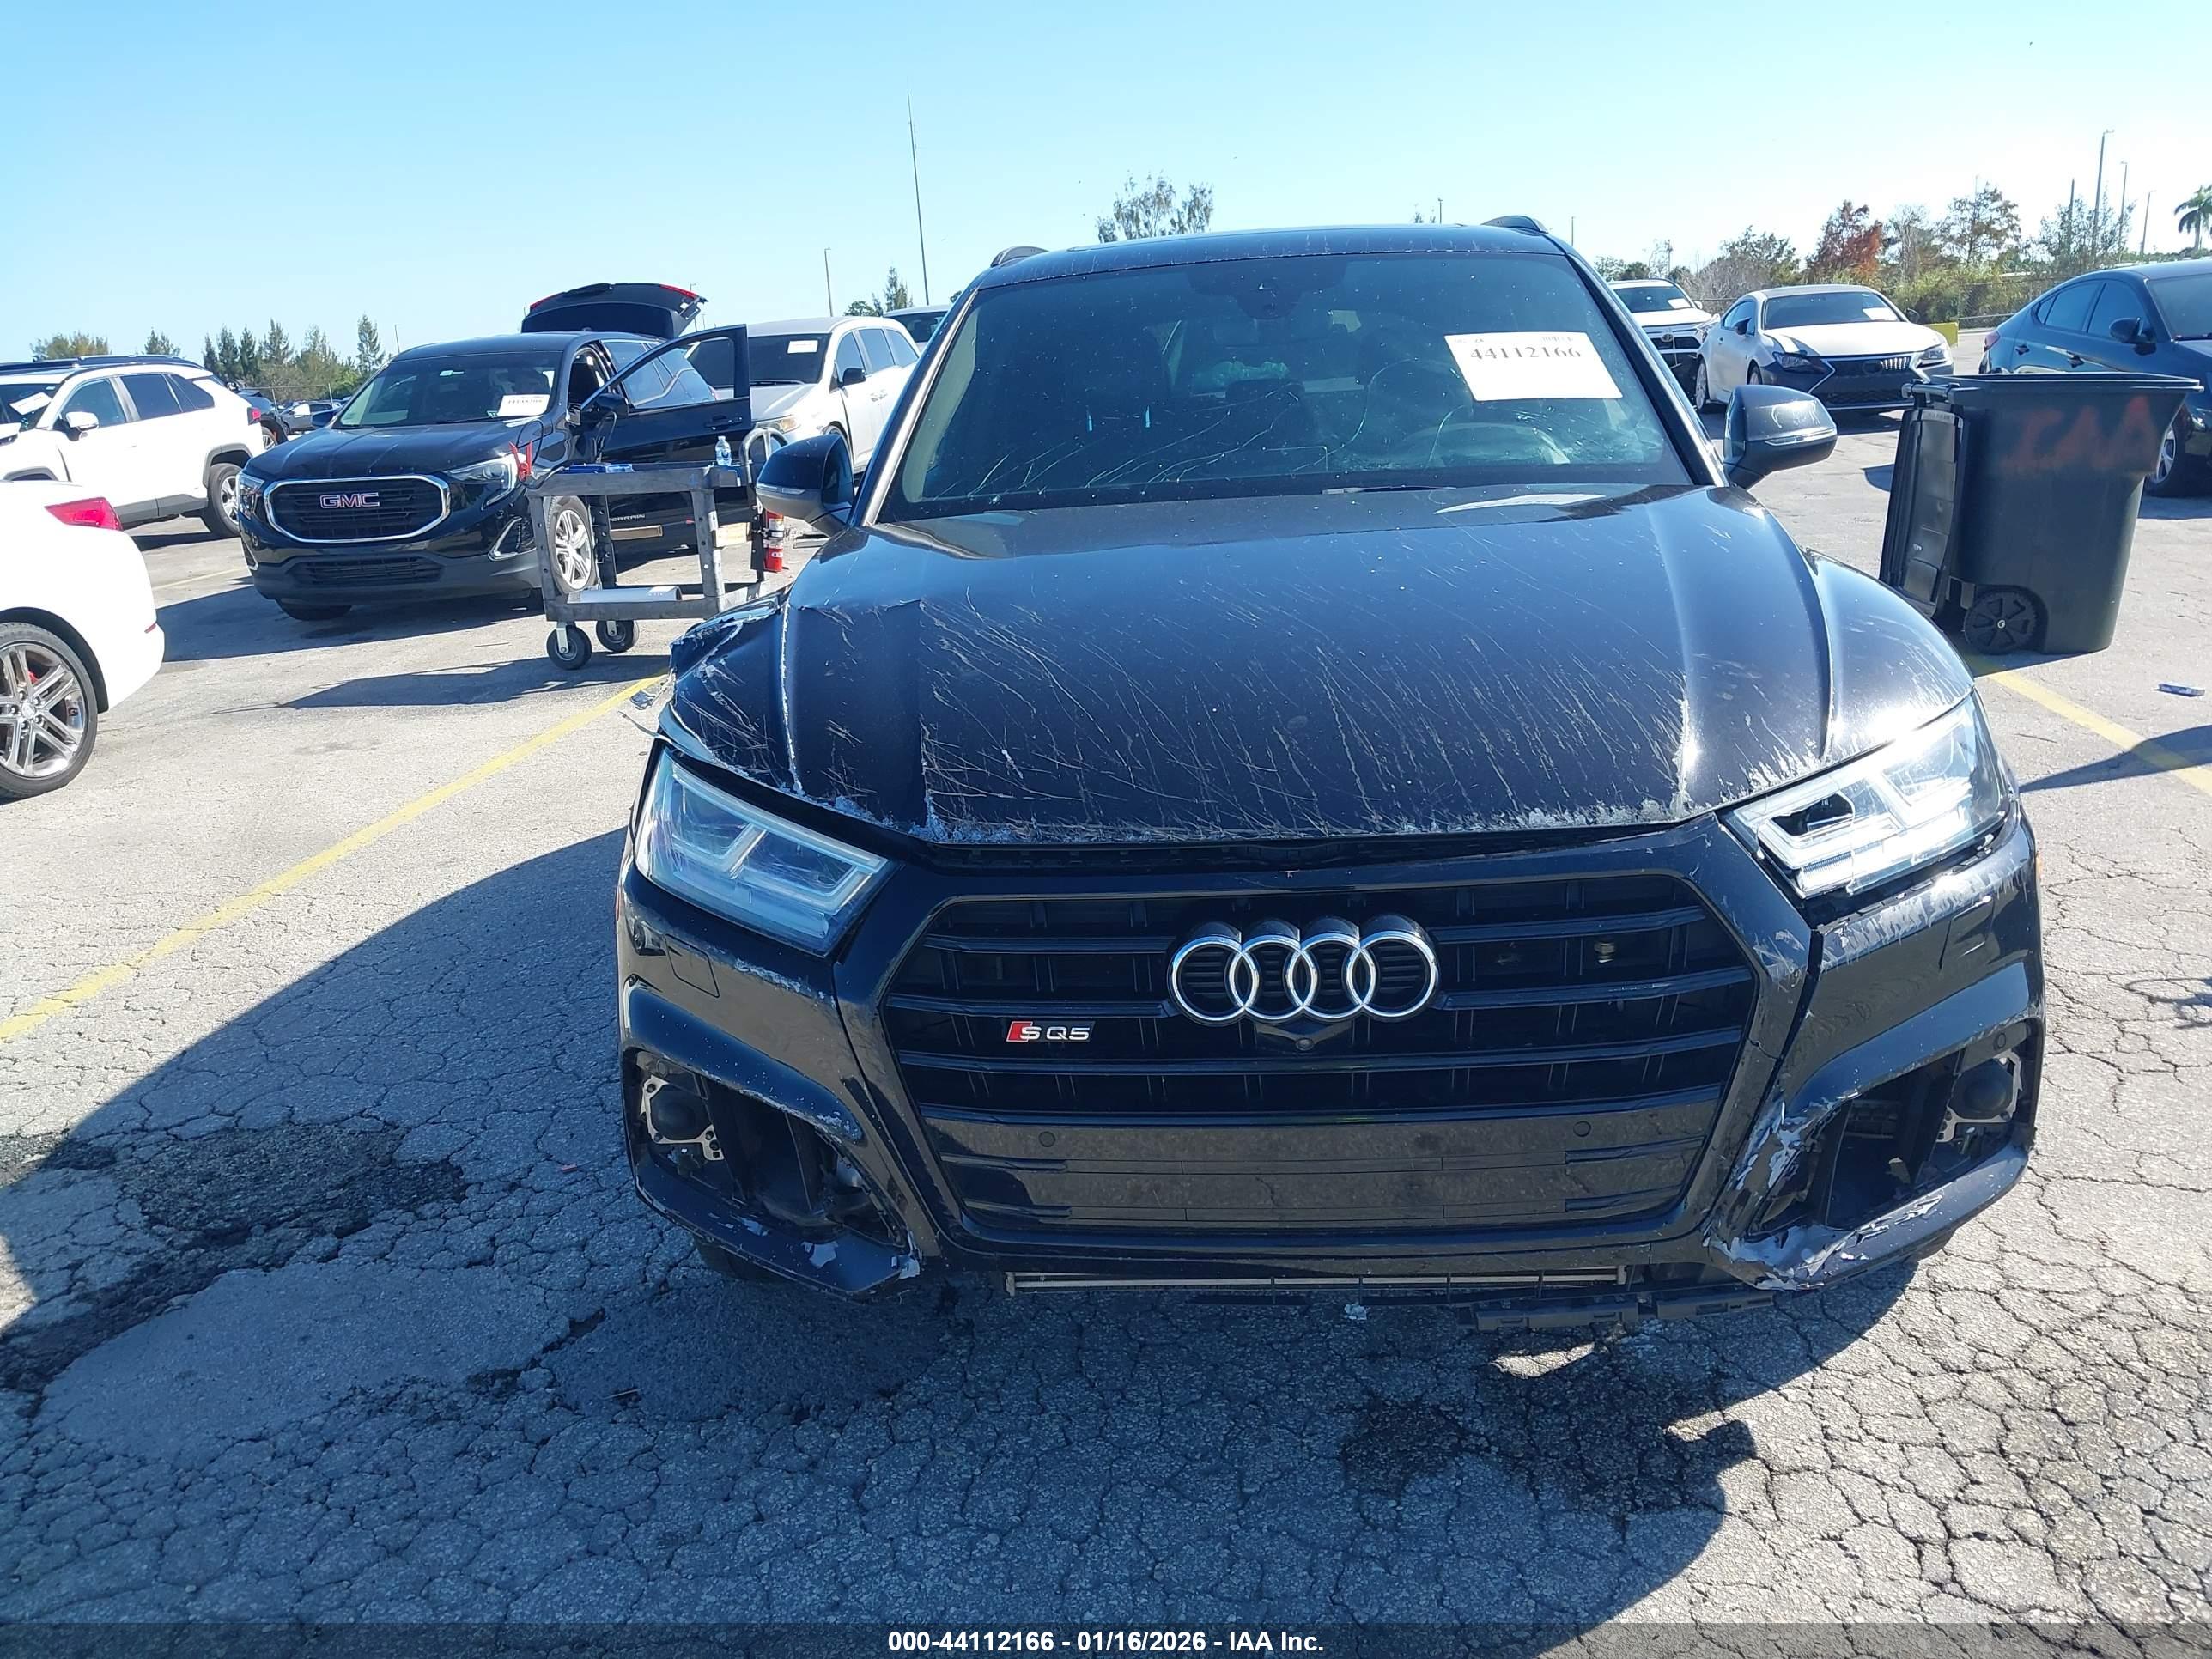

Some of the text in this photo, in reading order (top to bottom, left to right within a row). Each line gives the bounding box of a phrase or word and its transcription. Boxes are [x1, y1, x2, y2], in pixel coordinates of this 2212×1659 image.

[1470, 346, 1581, 359] 44112166
[2001, 394, 2159, 469] IAA
[319, 492, 380, 509] GMC
[1019, 1026, 1091, 1041] SQ5
